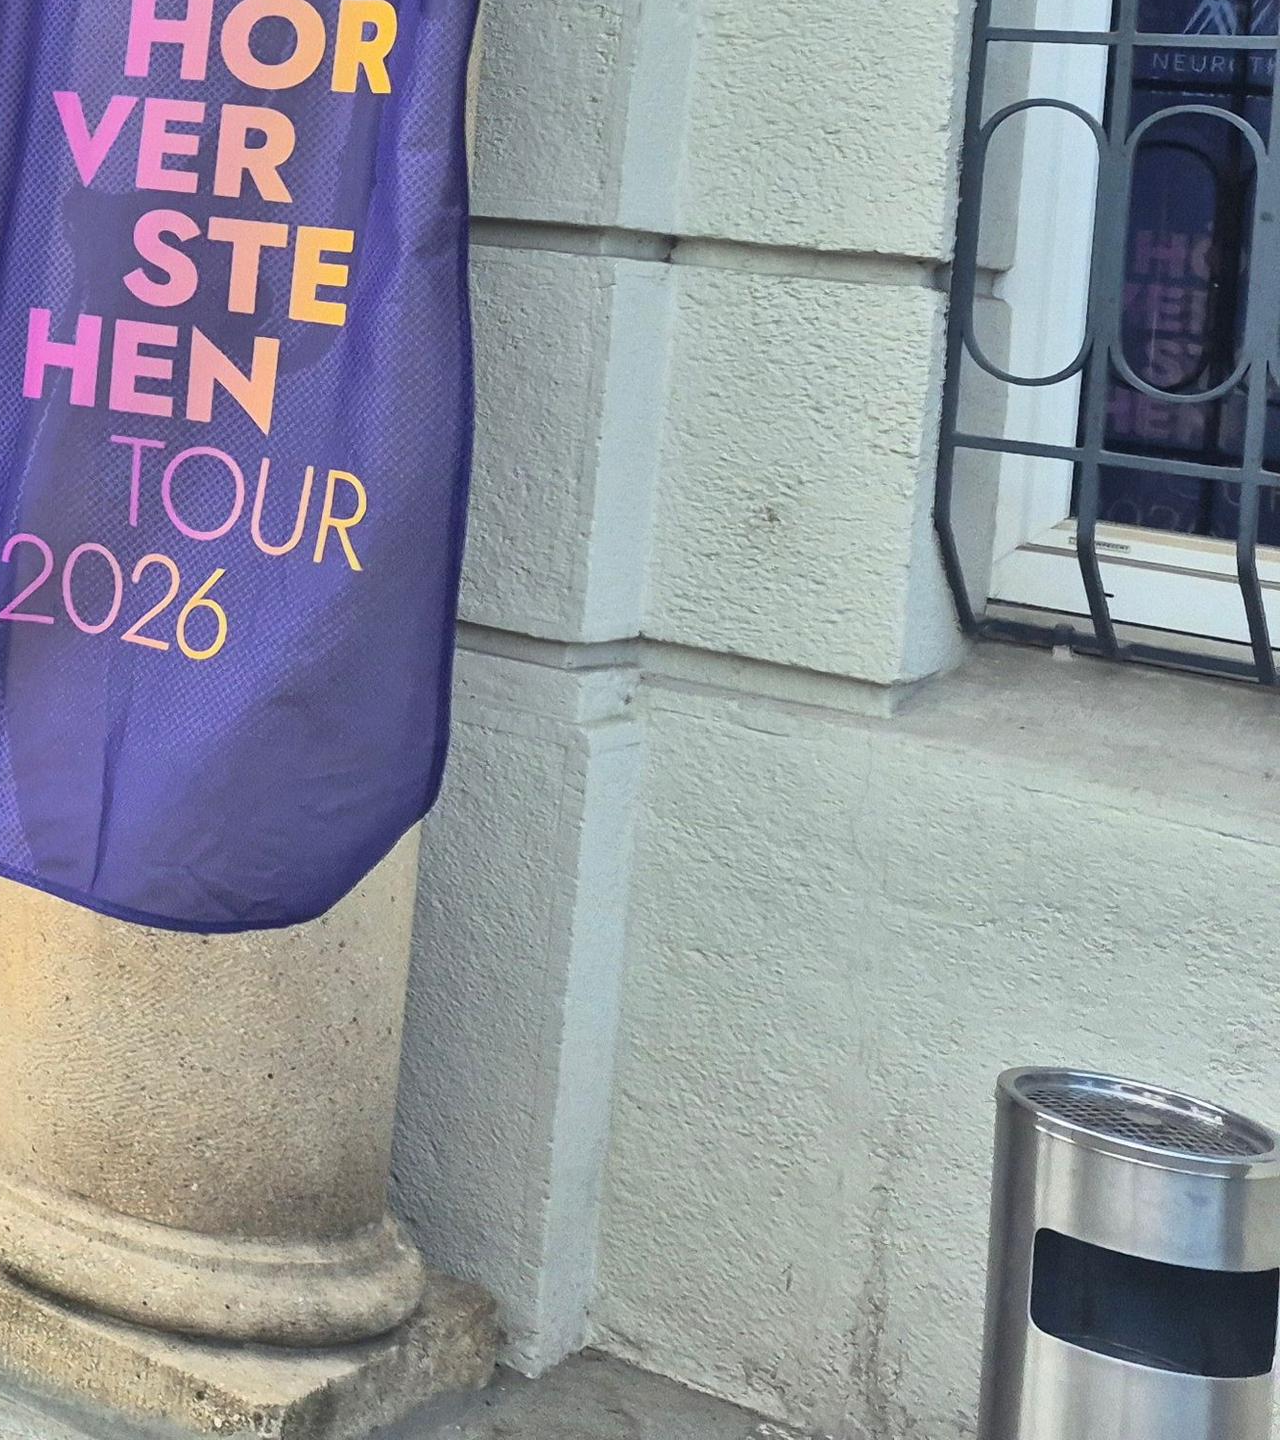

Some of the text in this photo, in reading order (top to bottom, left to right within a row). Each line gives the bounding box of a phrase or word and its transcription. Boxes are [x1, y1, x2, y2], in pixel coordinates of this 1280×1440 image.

[53, 91, 296, 204] VER
[123, 209, 355, 327] STE
[22, 308, 280, 436] HEN
[111, 434, 367, 572] TOUR
